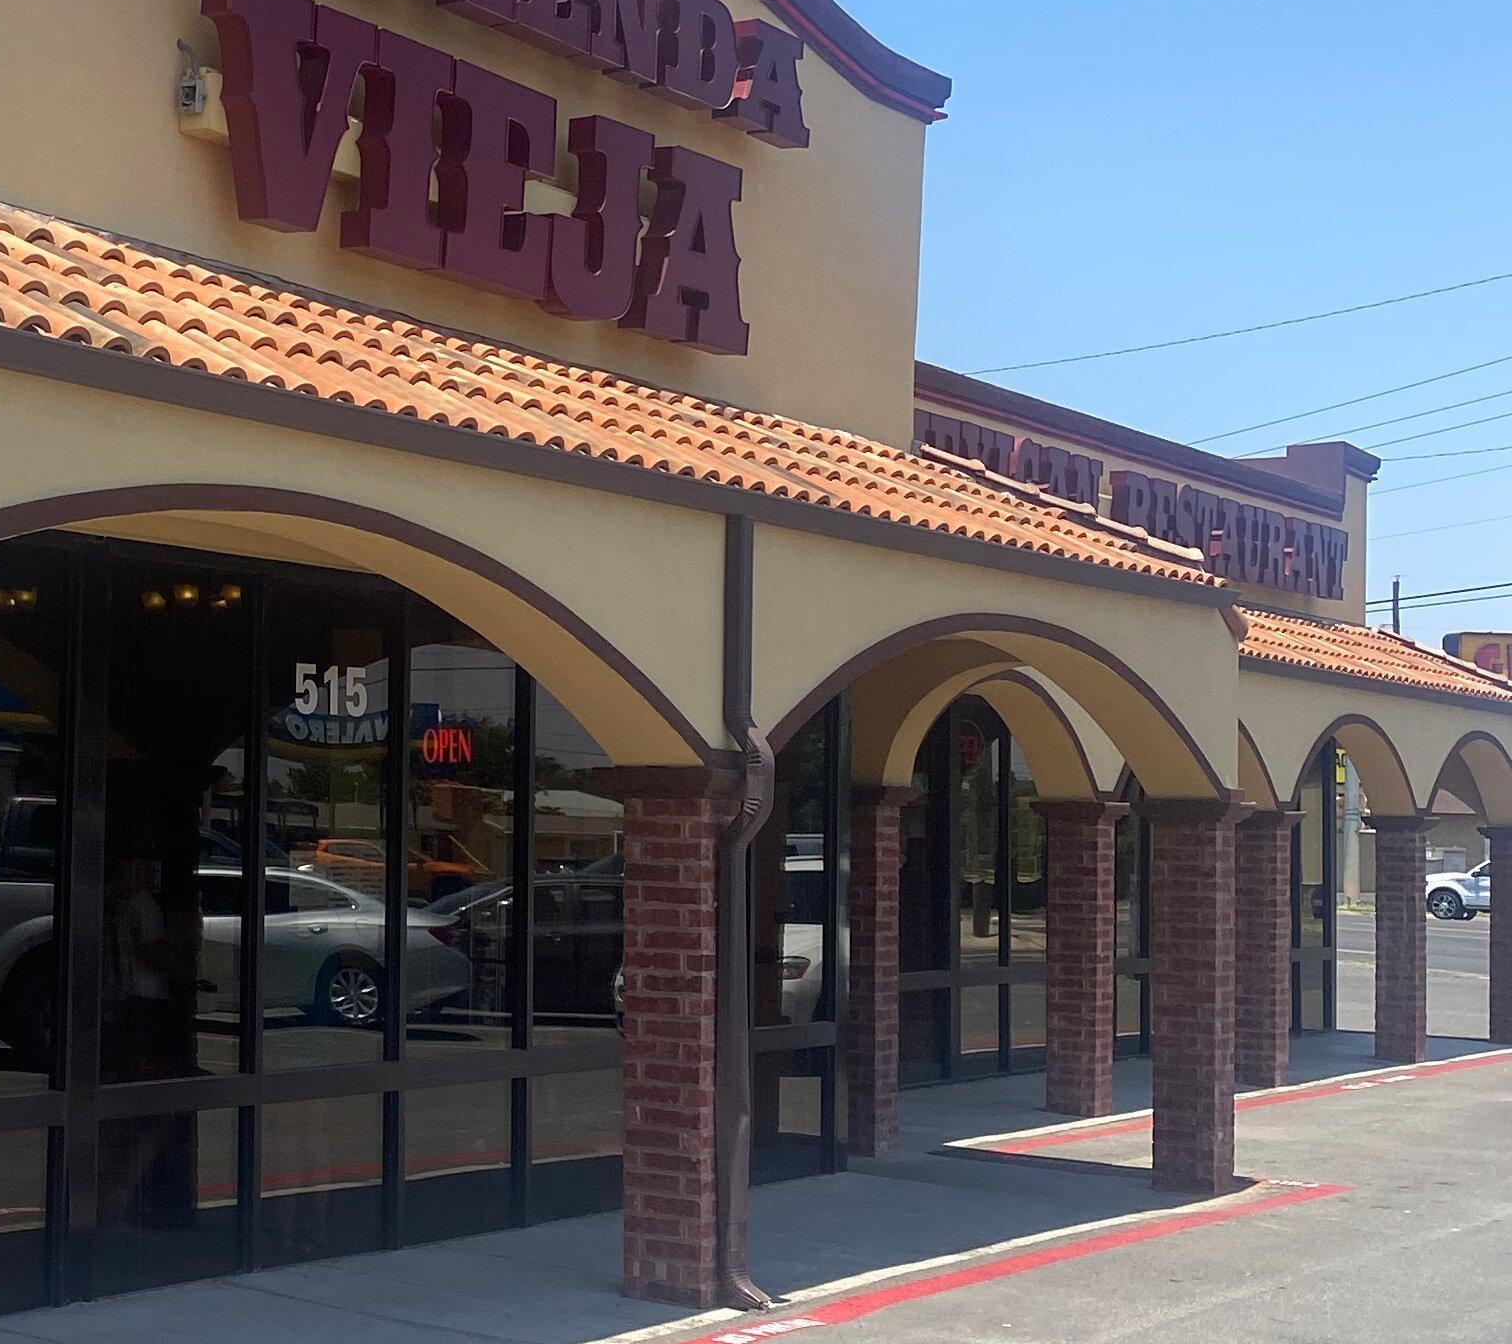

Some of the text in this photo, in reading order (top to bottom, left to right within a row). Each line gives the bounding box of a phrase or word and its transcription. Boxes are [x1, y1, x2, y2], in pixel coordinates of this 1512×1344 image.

[1110, 469, 1348, 601] RESTAURANT
[294, 662, 368, 718] 515
[422, 728, 473, 764] OPEN
